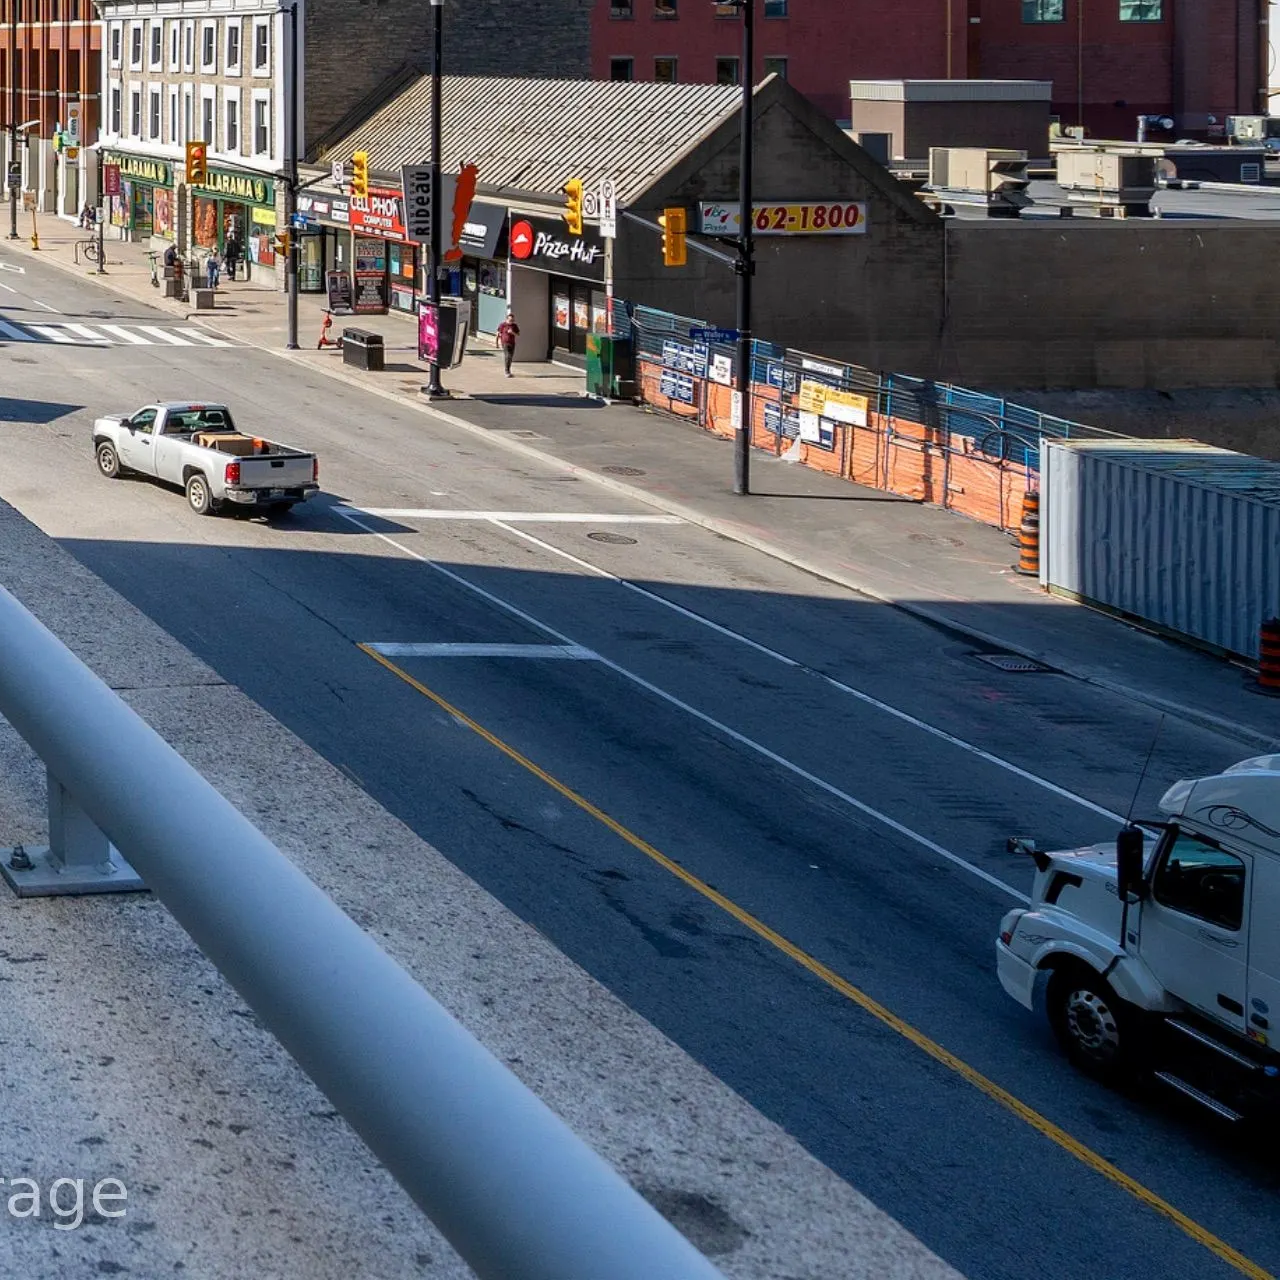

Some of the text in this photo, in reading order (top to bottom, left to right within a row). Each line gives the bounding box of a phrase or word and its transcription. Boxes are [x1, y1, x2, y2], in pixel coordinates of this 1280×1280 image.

[192, 172, 253, 198] LLARAMA
[751, 204, 859, 231] 62-1800
[533, 231, 601, 264] Pizza Hut
